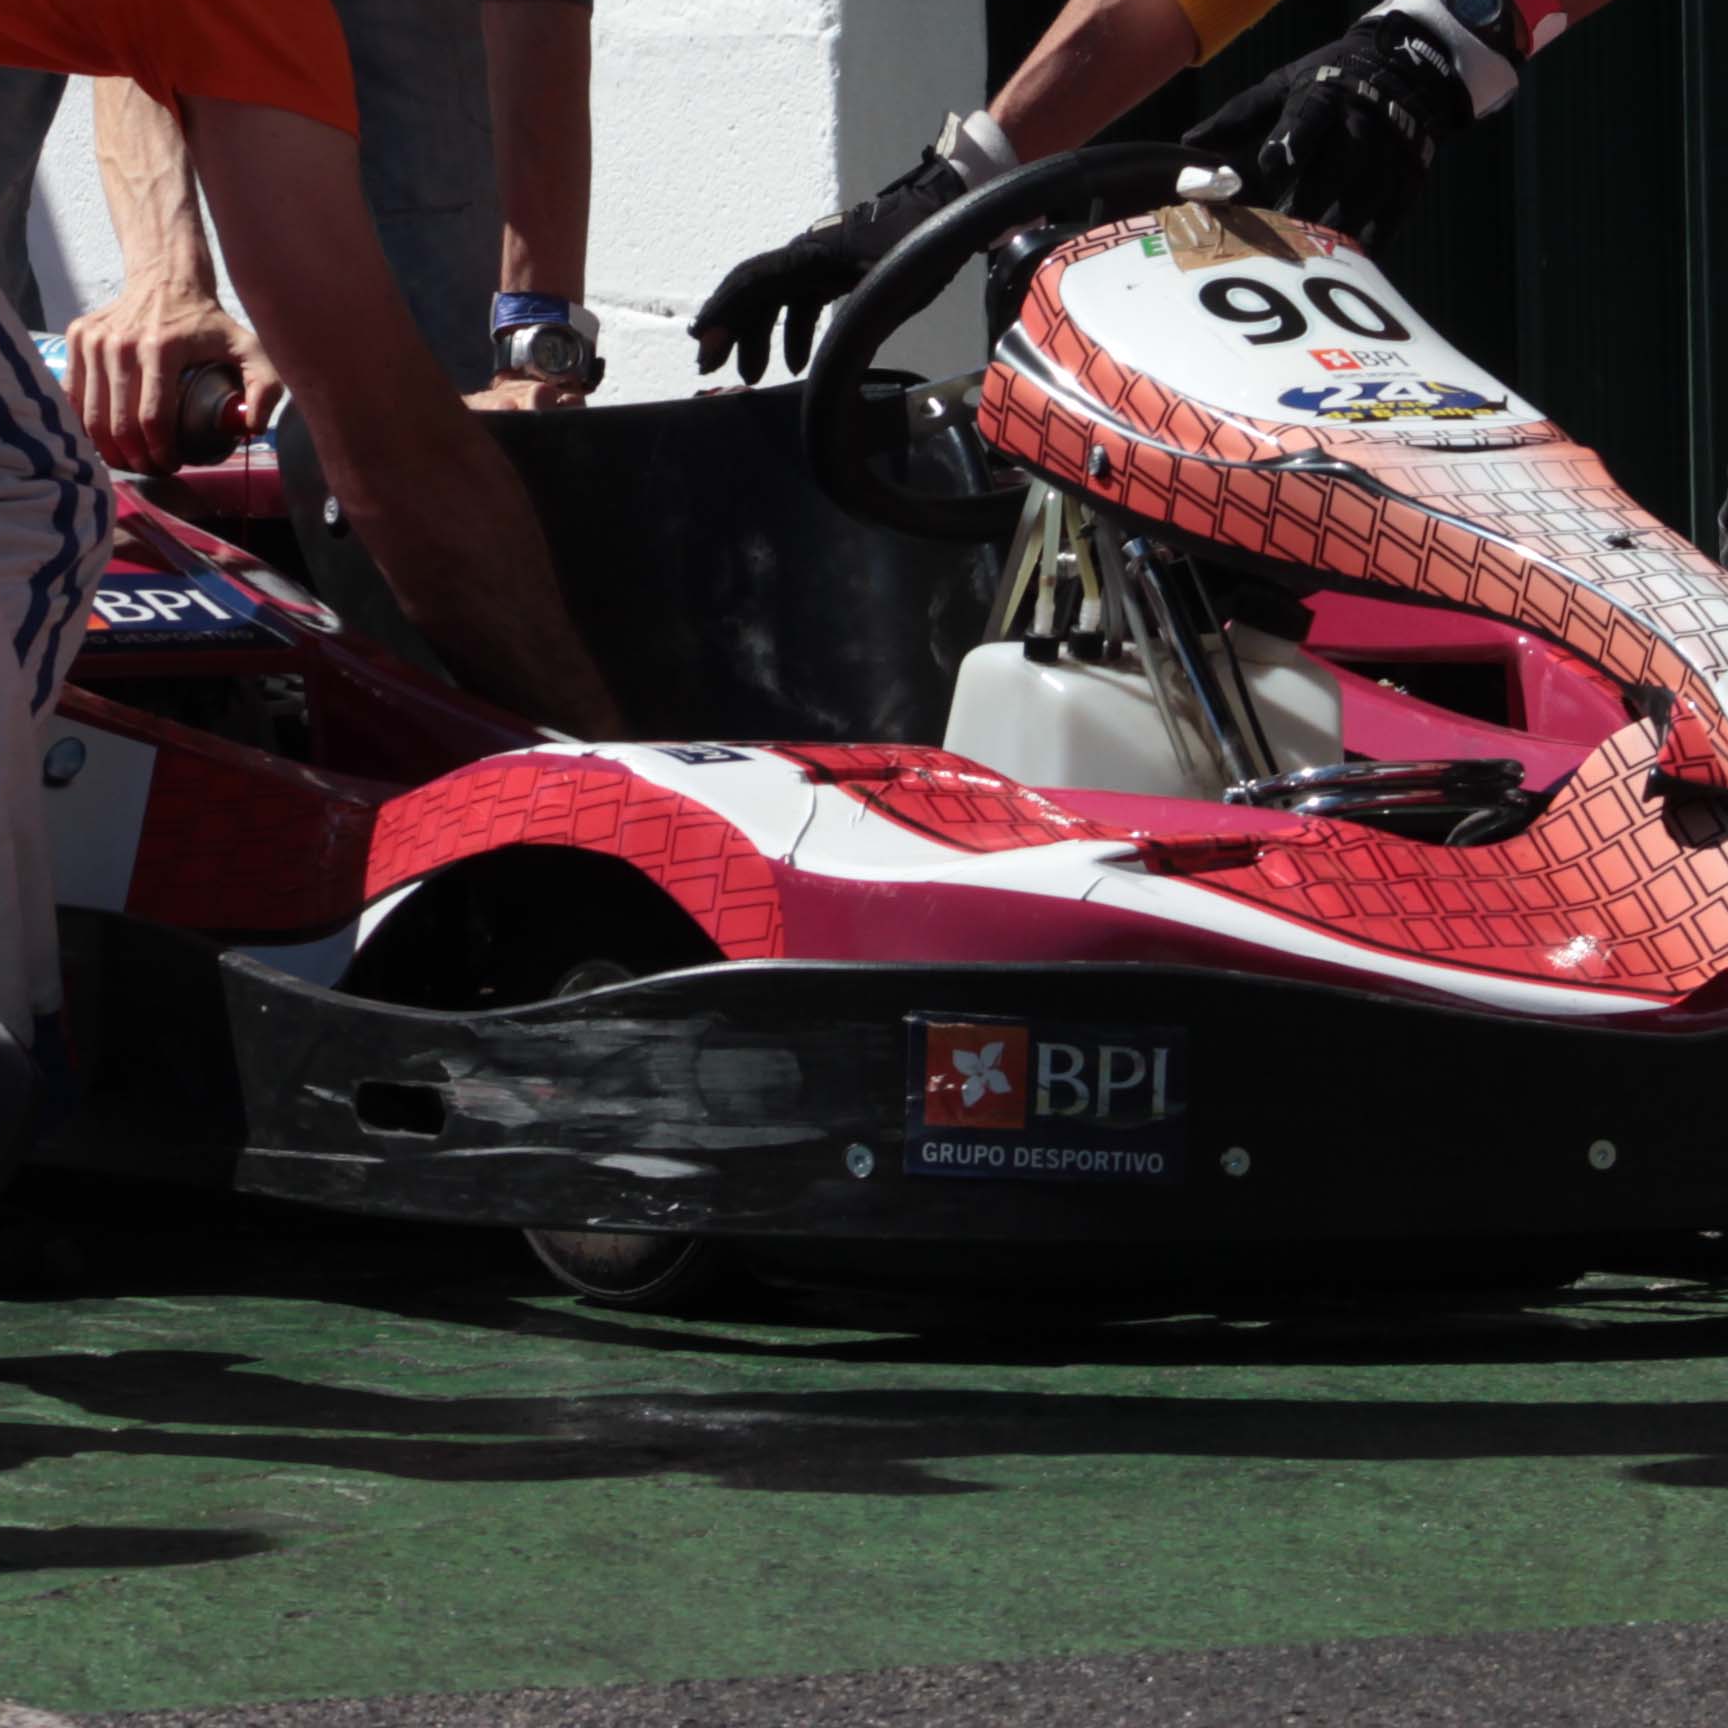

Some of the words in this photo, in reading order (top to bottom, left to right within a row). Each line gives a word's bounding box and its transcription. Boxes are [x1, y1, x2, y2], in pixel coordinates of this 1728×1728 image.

[1198, 276, 1412, 346] 90
[91, 588, 233, 623] BPI
[1035, 1041, 1170, 1121] BPI
[921, 1141, 1006, 1167] GRUPO
[1013, 1146, 1165, 1174] DESPORTIVO
